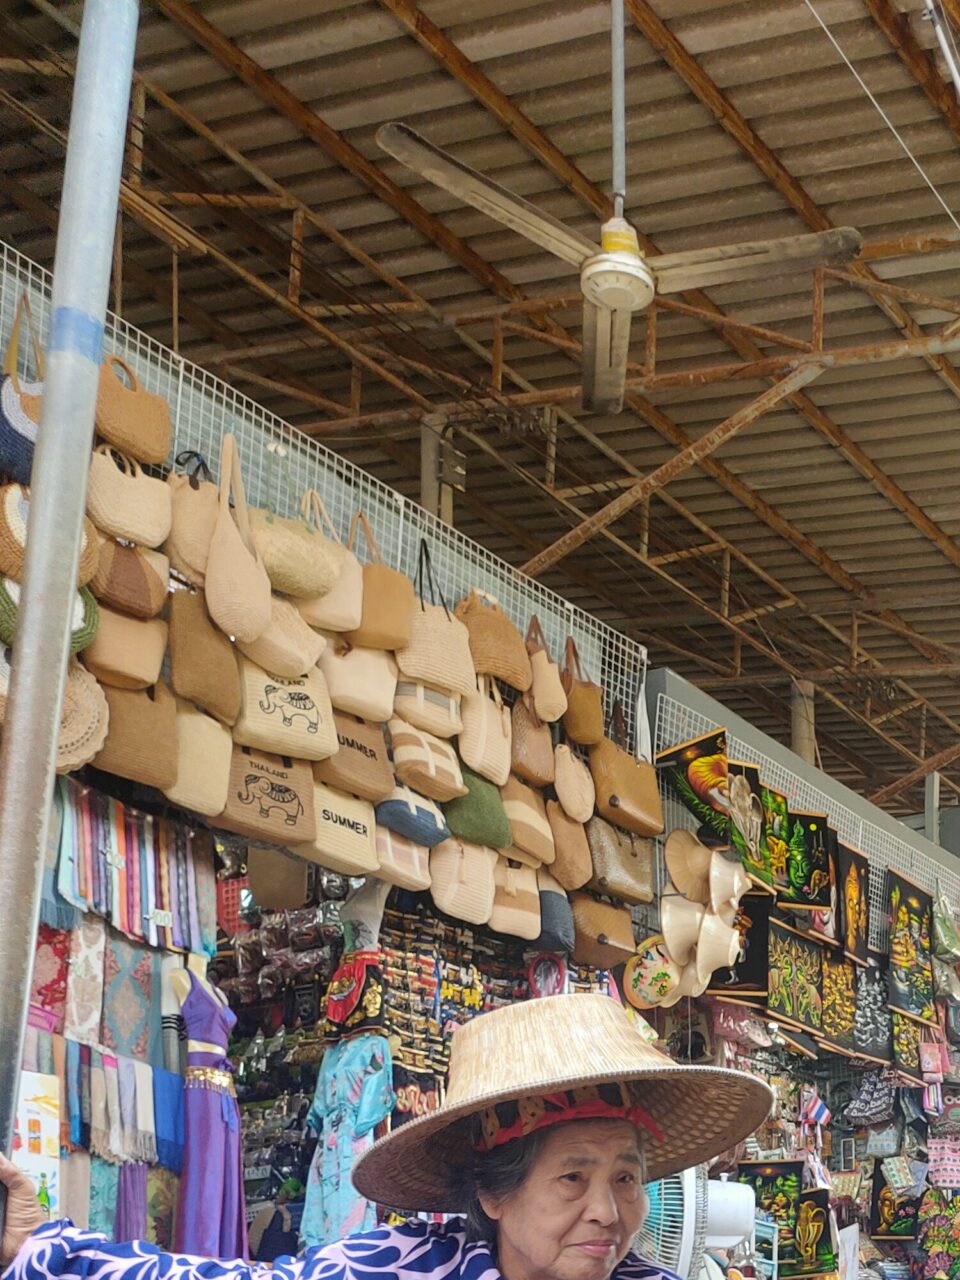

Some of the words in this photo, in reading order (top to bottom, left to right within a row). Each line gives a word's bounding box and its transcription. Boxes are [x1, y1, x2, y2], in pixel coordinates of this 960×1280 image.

[336, 733, 378, 761] UMMER
[248, 760, 289, 780] THAILAND
[322, 808, 368, 838] SUMMER
